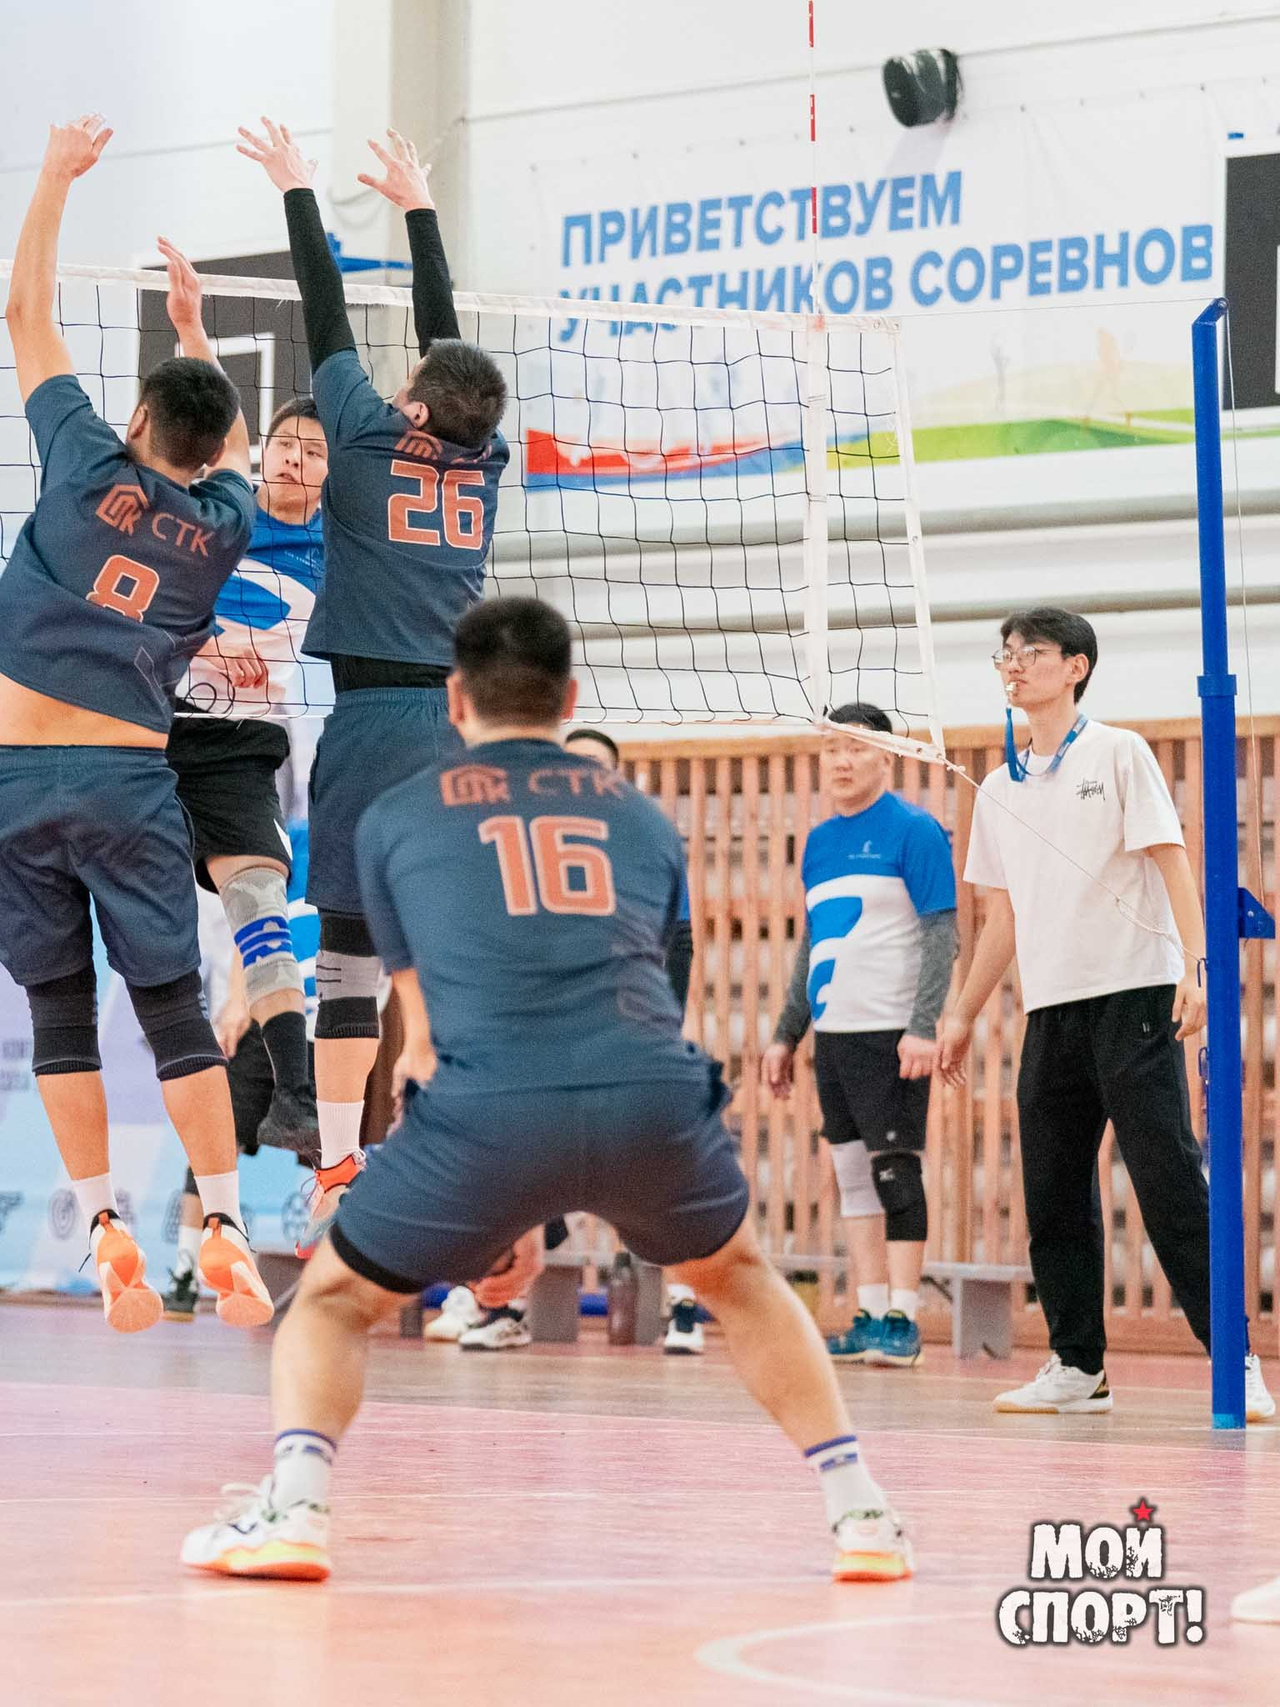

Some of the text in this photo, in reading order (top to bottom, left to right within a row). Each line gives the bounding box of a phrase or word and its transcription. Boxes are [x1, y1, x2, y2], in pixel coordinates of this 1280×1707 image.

[562, 171, 961, 267] ПРИВЕТСТВУЕМ
[558, 224, 1213, 342] УЧАСТНИКОВ СОРЕВНОВ
[151, 511, 216, 557] СТК
[387, 459, 485, 550] 26
[85, 554, 160, 623] 8
[528, 767, 624, 799] СТК
[477, 815, 617, 917] 16
